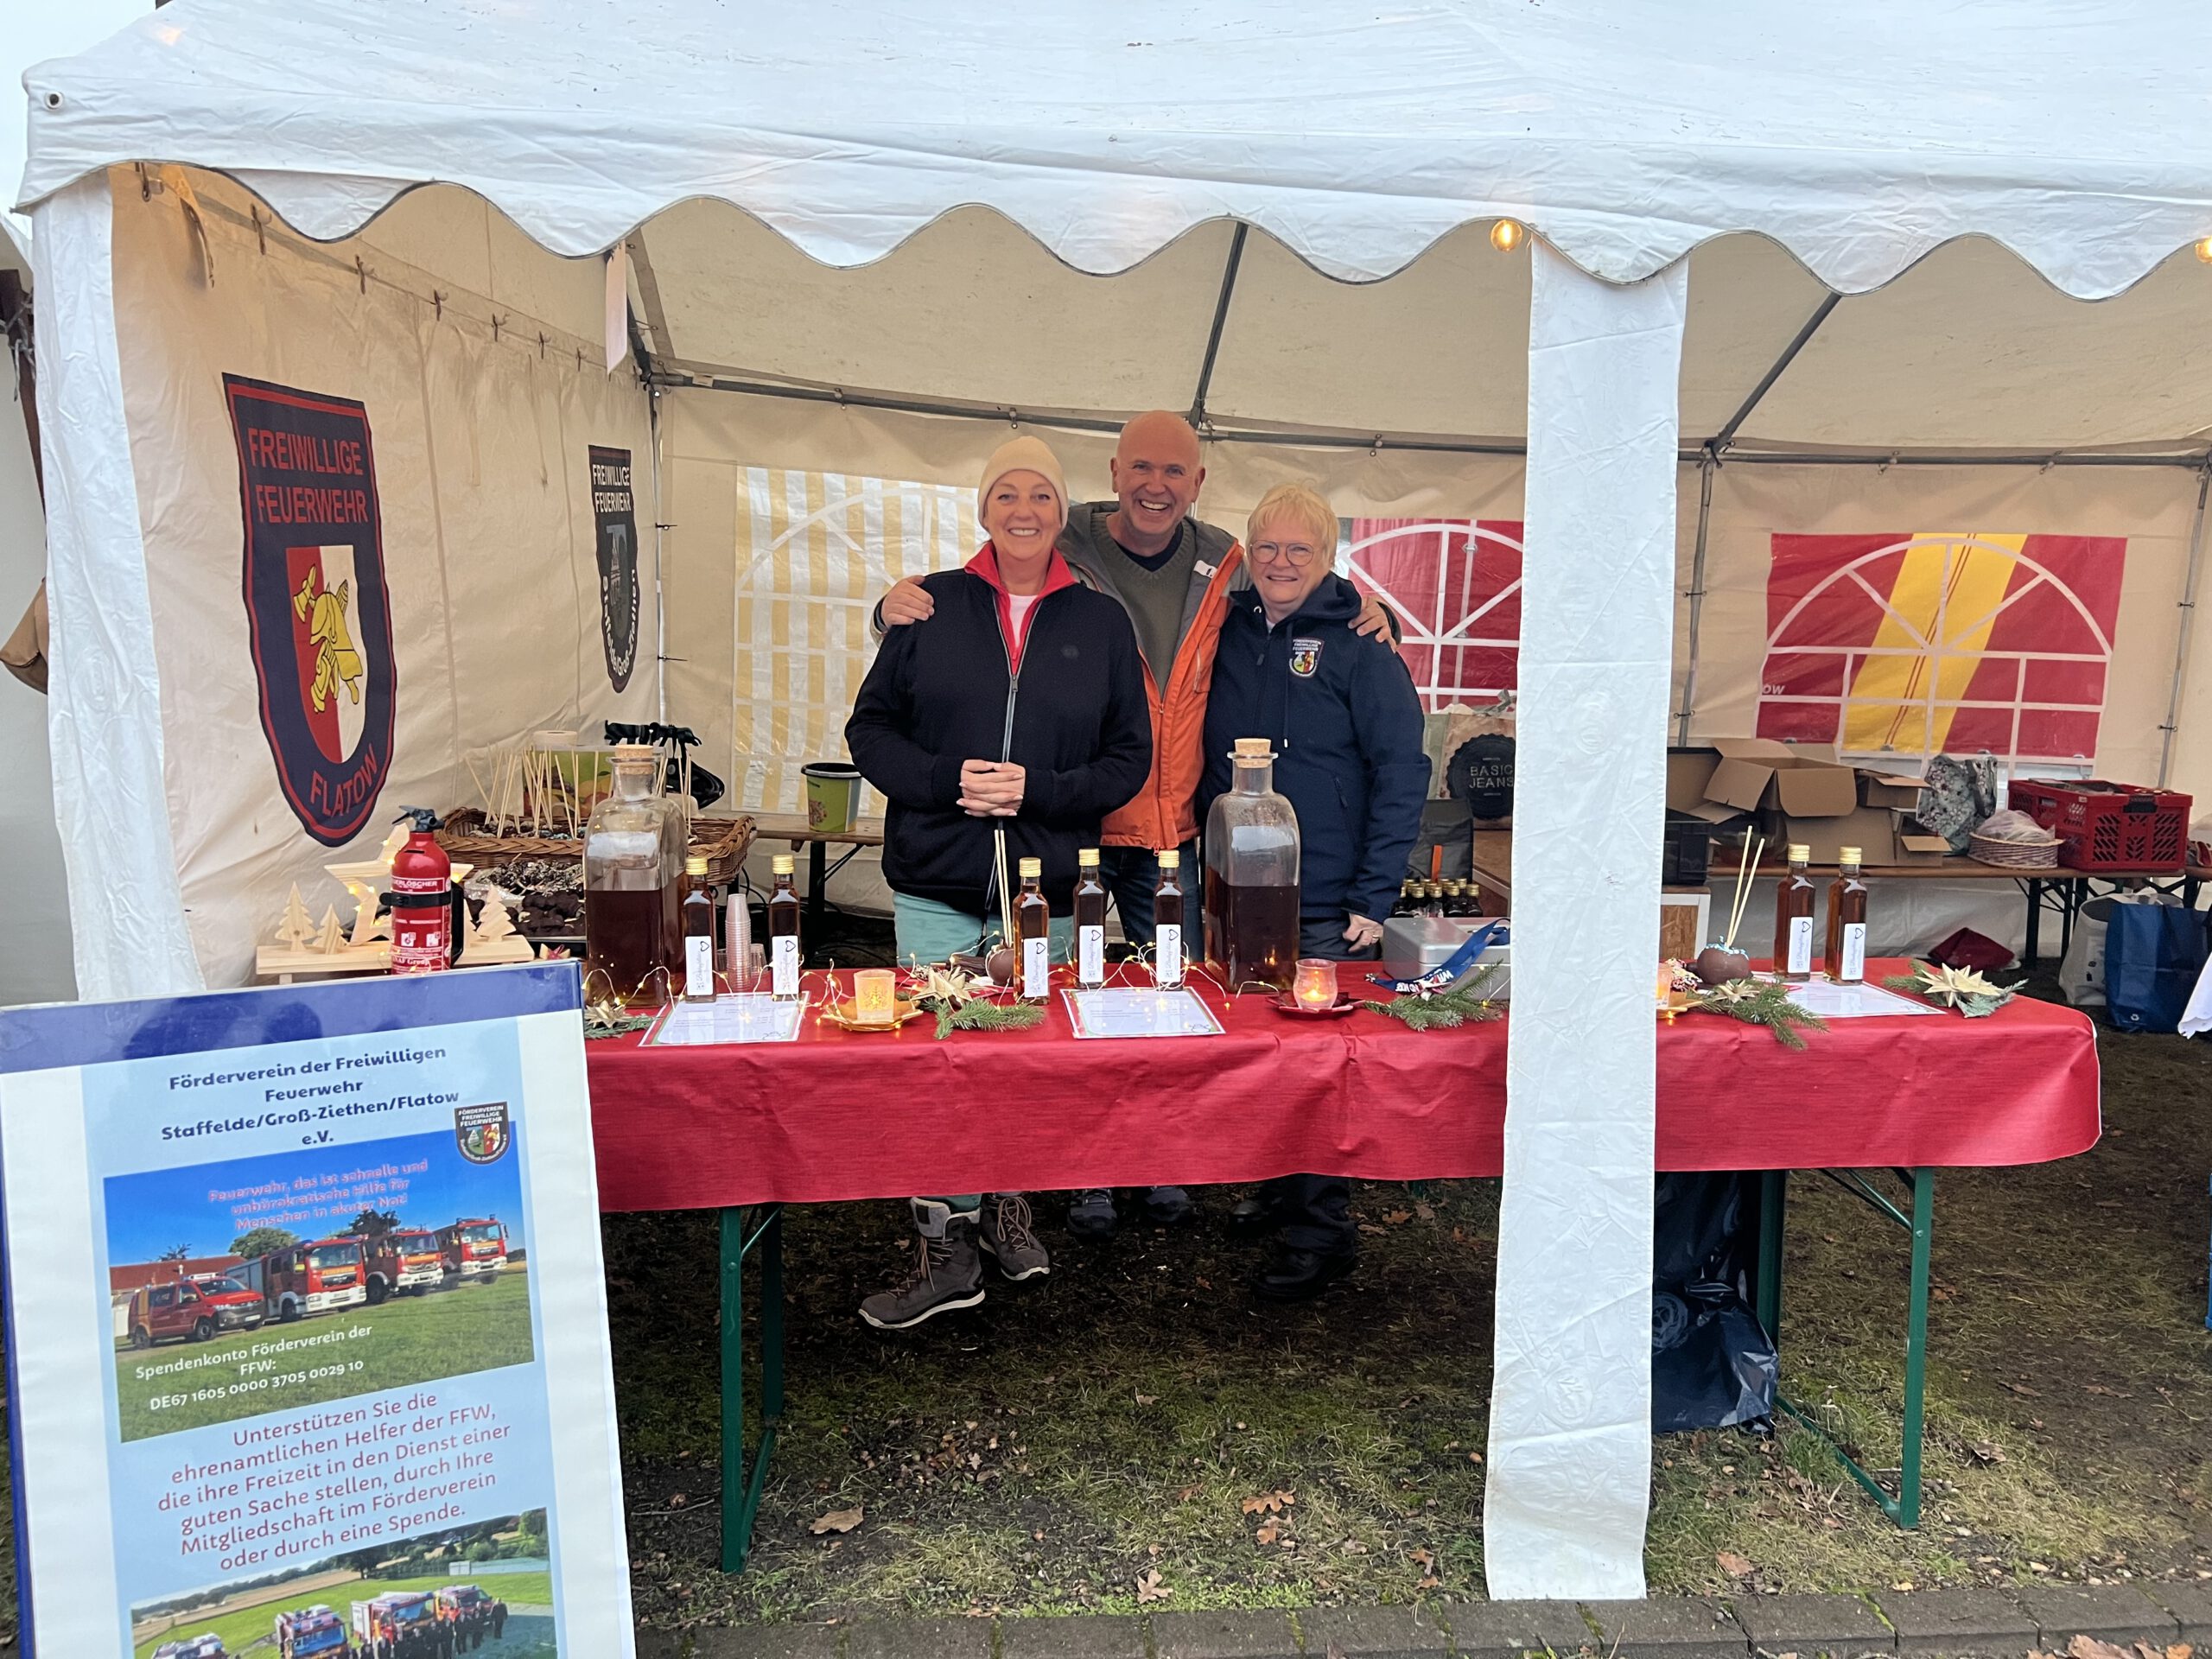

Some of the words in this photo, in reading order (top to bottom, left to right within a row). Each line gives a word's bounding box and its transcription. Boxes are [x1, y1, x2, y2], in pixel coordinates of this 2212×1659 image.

[247, 427, 364, 476] FREIWILLIGE
[592, 464, 630, 486] FREIWILLIGE
[255, 486, 369, 524] FEUERWEHR
[594, 492, 632, 513] FEUERWEHR
[309, 741, 378, 817] FLATOW
[1469, 777, 1514, 789] JEANS
[1470, 764, 1514, 777] BASIC
[169, 1063, 296, 1090] Förderverein
[300, 1060, 333, 1075] der
[335, 1046, 447, 1071] Freiwilligen
[265, 1080, 364, 1103] Feuerwehr
[162, 1092, 460, 1141] Staffelde/Groß-Ziethen/Flatow
[302, 1130, 334, 1146] e.V.
[460, 1116, 503, 1127] FEUERWEHR
[208, 1180, 290, 1203] Feuerwehr,
[294, 1176, 317, 1191] das
[321, 1173, 337, 1186] ist
[341, 1164, 399, 1182] schnelle
[401, 1159, 429, 1174] und
[232, 1187, 349, 1215] unbürokratische
[353, 1180, 386, 1197] Hilfe
[390, 1177, 410, 1192] für
[235, 1210, 309, 1230] Menschen
[314, 1205, 327, 1218] in
[331, 1200, 375, 1217] akuter
[378, 1194, 409, 1208] Not!
[135, 1349, 248, 1380] Spendenkonto
[251, 1331, 346, 1357] Förderverein
[348, 1325, 373, 1338] der
[239, 1359, 276, 1376] FFW:
[149, 1394, 188, 1410] DE67
[192, 1386, 226, 1402] 1605
[229, 1379, 269, 1395] 0000
[272, 1370, 307, 1389] 3705
[309, 1363, 346, 1378] 0029
[348, 1360, 365, 1371] 10
[232, 1408, 368, 1447] Unterstützen
[372, 1400, 403, 1419] Sie
[407, 1392, 438, 1412] die
[171, 1438, 339, 1484] ehrenamtlichen
[345, 1421, 407, 1448] Helfer
[411, 1414, 444, 1433] der
[449, 1402, 497, 1426] FFW,
[157, 1492, 193, 1512] die
[196, 1482, 239, 1503] ihre
[245, 1462, 323, 1493] Freizeit
[327, 1459, 346, 1476] in
[352, 1449, 390, 1468] den
[396, 1436, 459, 1460] Dienst
[463, 1423, 512, 1446] einer
[180, 1508, 243, 1535] guten
[247, 1491, 309, 1517] Sache
[315, 1474, 388, 1502] stellen,
[393, 1458, 451, 1484] durch
[455, 1451, 495, 1470] Ihre
[181, 1508, 335, 1555] Mitgliedschaft
[340, 1502, 366, 1519] im
[372, 1471, 497, 1512] Förderverein
[219, 1548, 268, 1571] oder
[274, 1532, 335, 1558] durch
[340, 1521, 384, 1542] eine
[388, 1503, 467, 1534] Spende.
